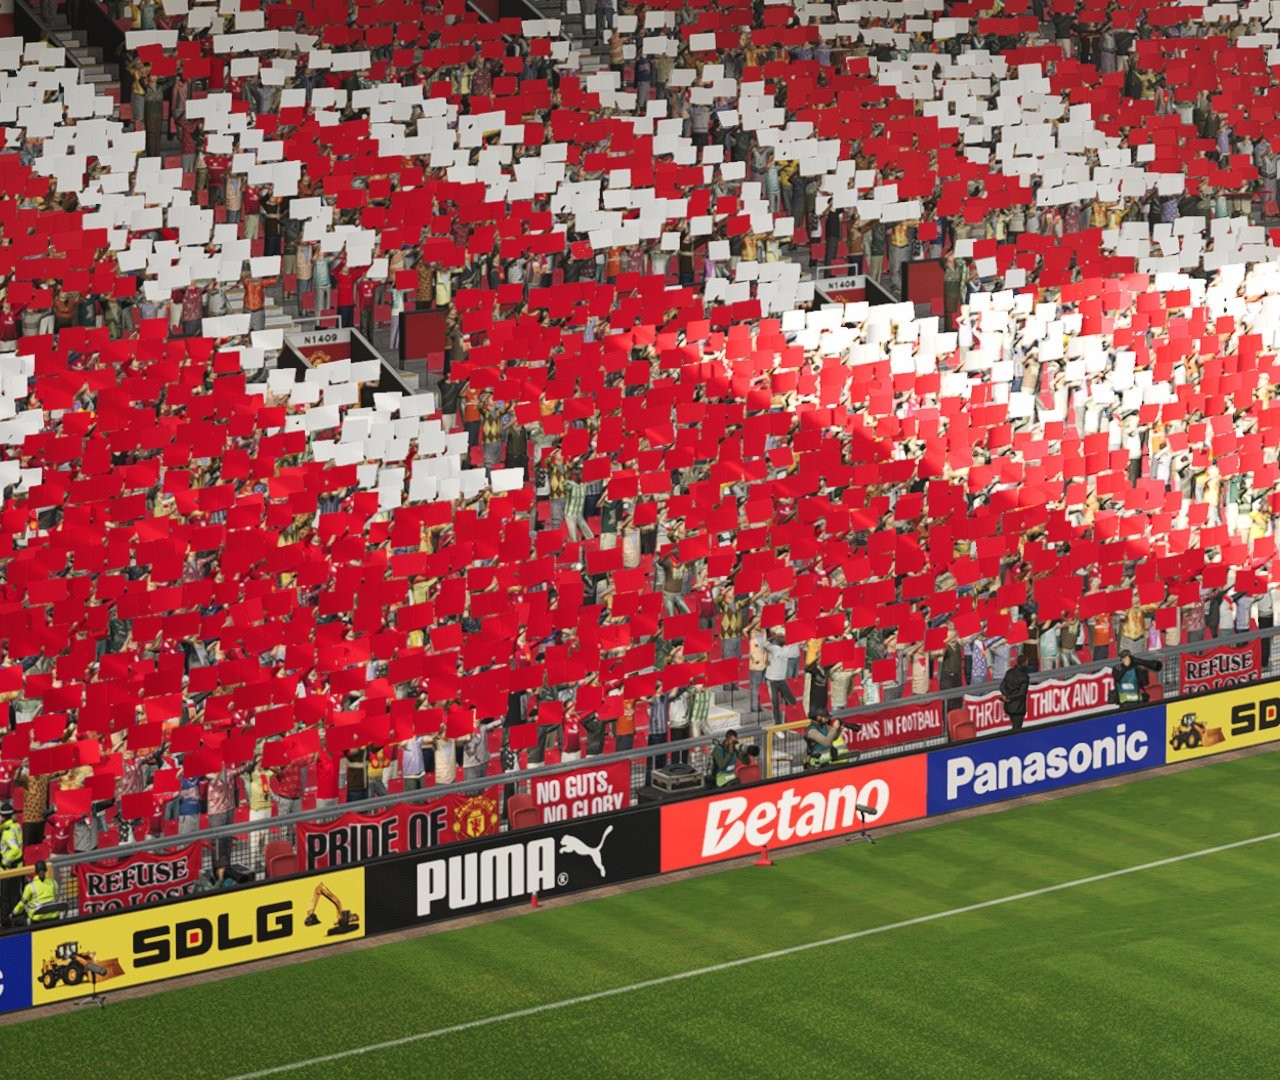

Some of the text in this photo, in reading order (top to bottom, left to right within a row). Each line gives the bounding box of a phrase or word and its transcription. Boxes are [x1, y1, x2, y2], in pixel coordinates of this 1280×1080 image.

[304, 333, 337, 344] N1409
[1186, 651, 1253, 680] REFUSE
[1030, 686, 1071, 717] THICK
[1072, 682, 1098, 709] AND
[884, 718, 894, 737] IN
[895, 709, 941, 735] FOOTBALL
[946, 723, 1149, 801] Panasonic
[536, 770, 613, 805] NO GUTS,
[306, 816, 399, 871] PRIDE
[409, 806, 448, 852] OF
[701, 778, 890, 858] Betano
[86, 856, 189, 897] REFUSE
[417, 837, 556, 917] PUMA
[133, 900, 293, 968] SDLG
